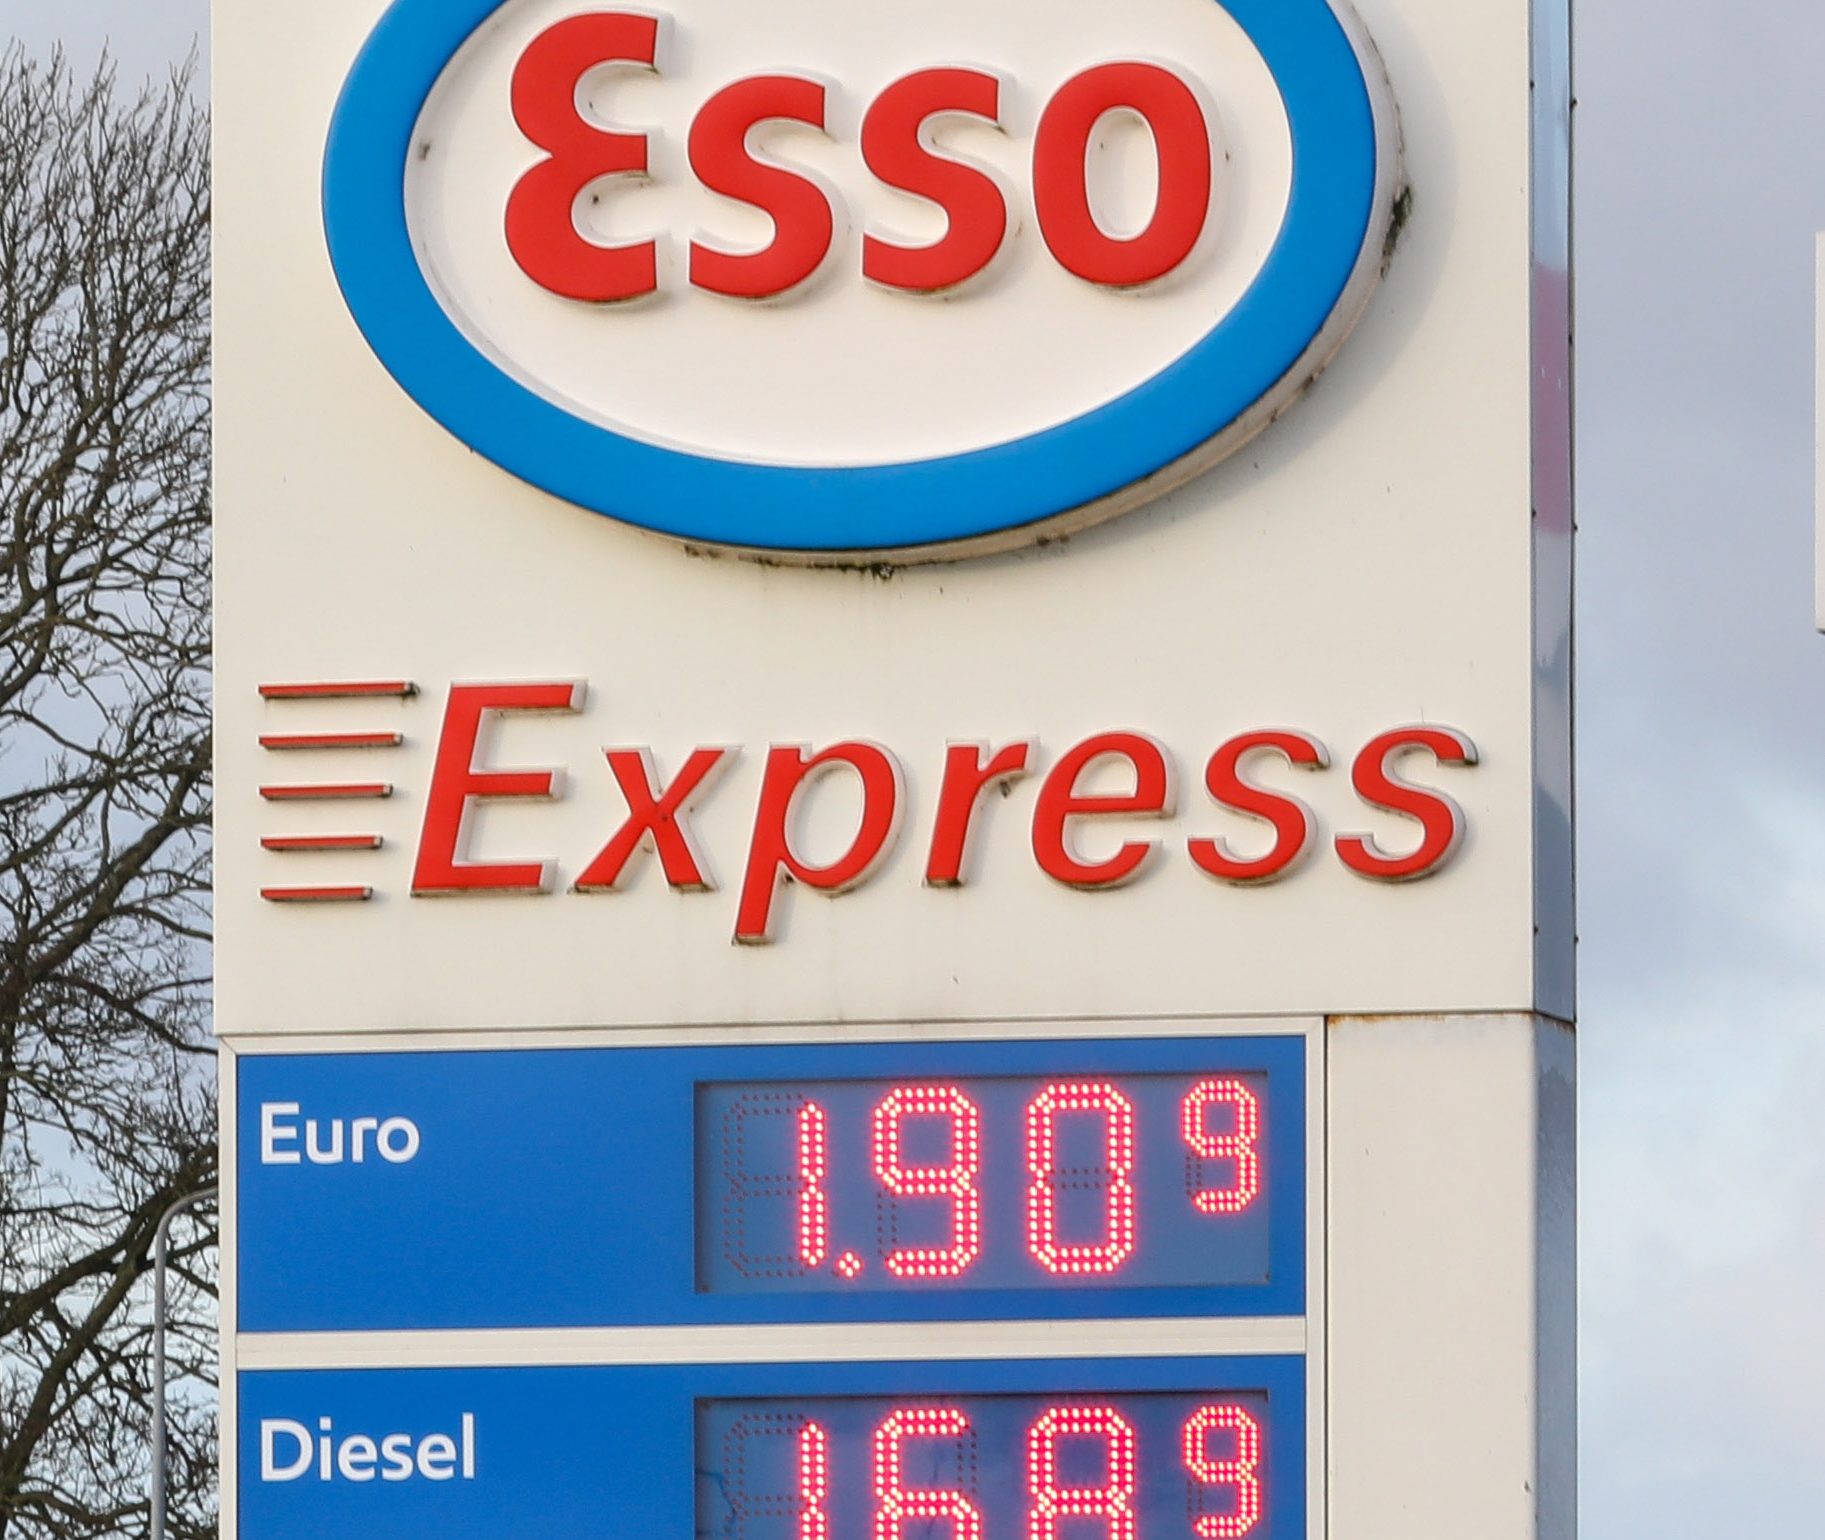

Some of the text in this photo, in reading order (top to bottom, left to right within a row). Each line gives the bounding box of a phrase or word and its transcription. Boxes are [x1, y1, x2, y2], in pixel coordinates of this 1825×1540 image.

[409, 682, 1477, 942] Express
[259, 1100, 421, 1165] Euro
[259, 1411, 476, 1483] Diesel
